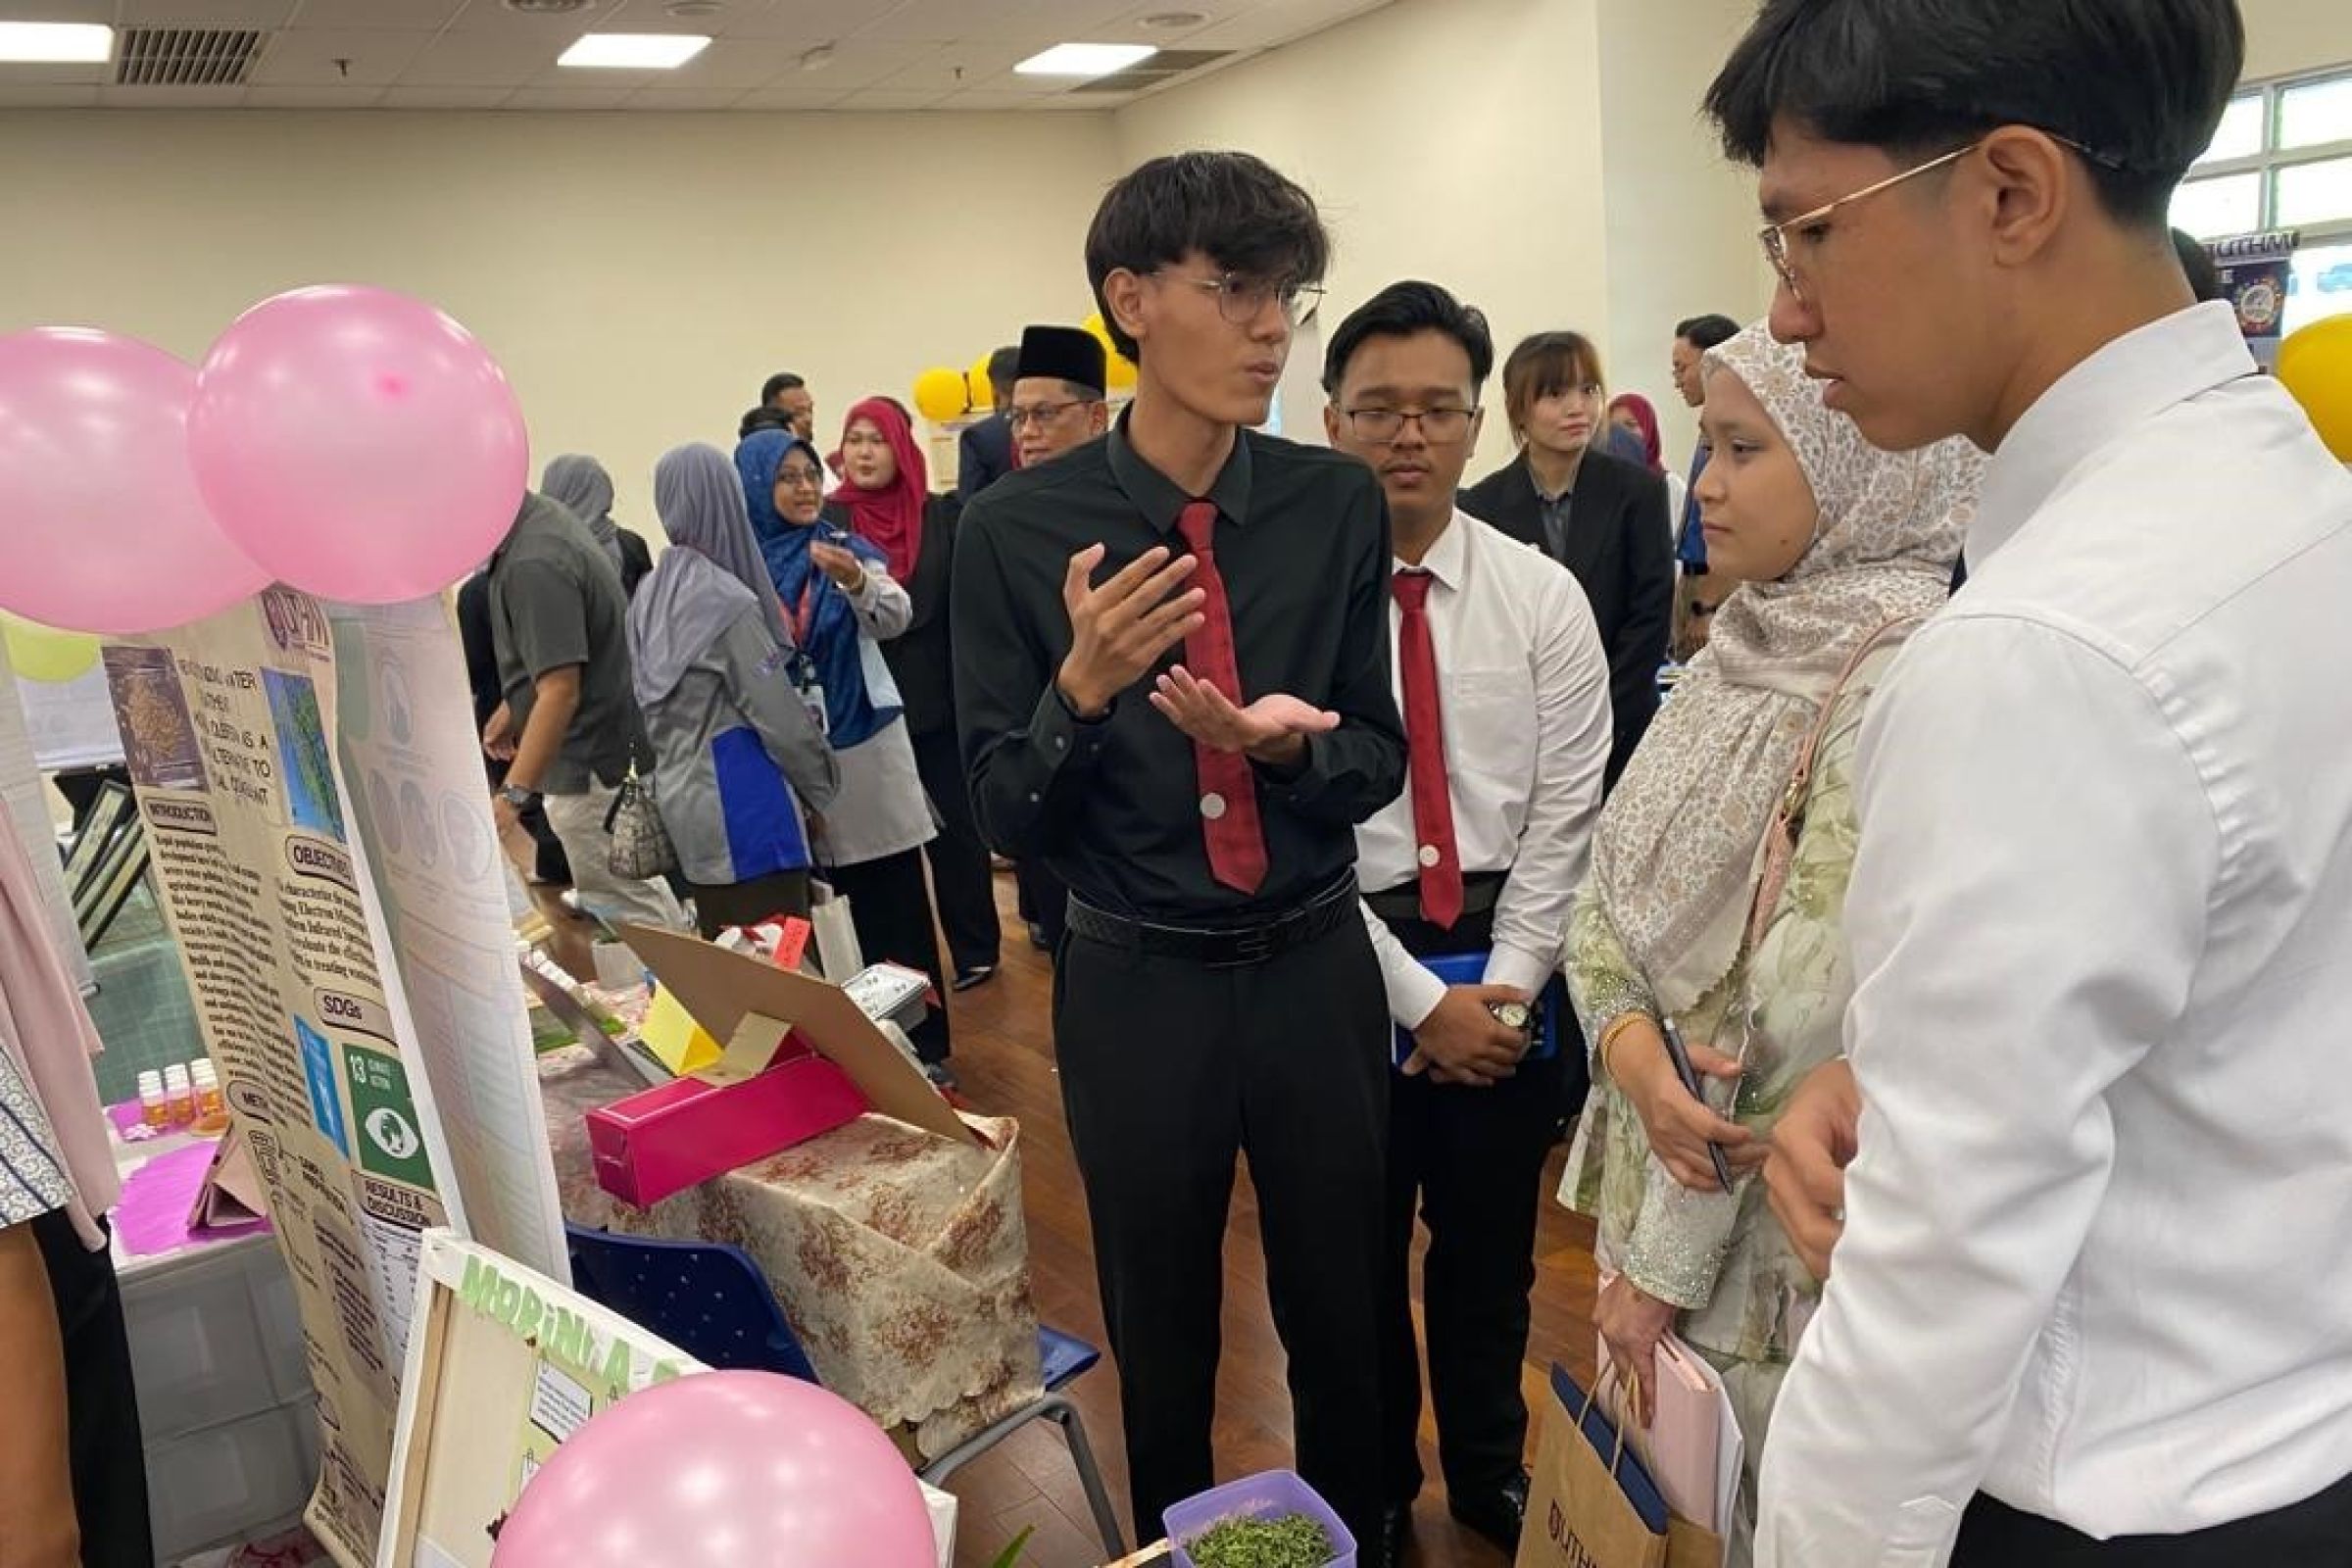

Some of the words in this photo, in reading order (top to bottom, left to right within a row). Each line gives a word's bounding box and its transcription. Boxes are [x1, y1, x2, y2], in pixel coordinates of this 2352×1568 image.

[252, 759, 270, 778] TO
[323, 995, 363, 1021] SDGs
[349, 1053, 368, 1085] 13
[365, 1180, 413, 1208] RESULTS
[368, 1196, 432, 1227] DISCUSSION
